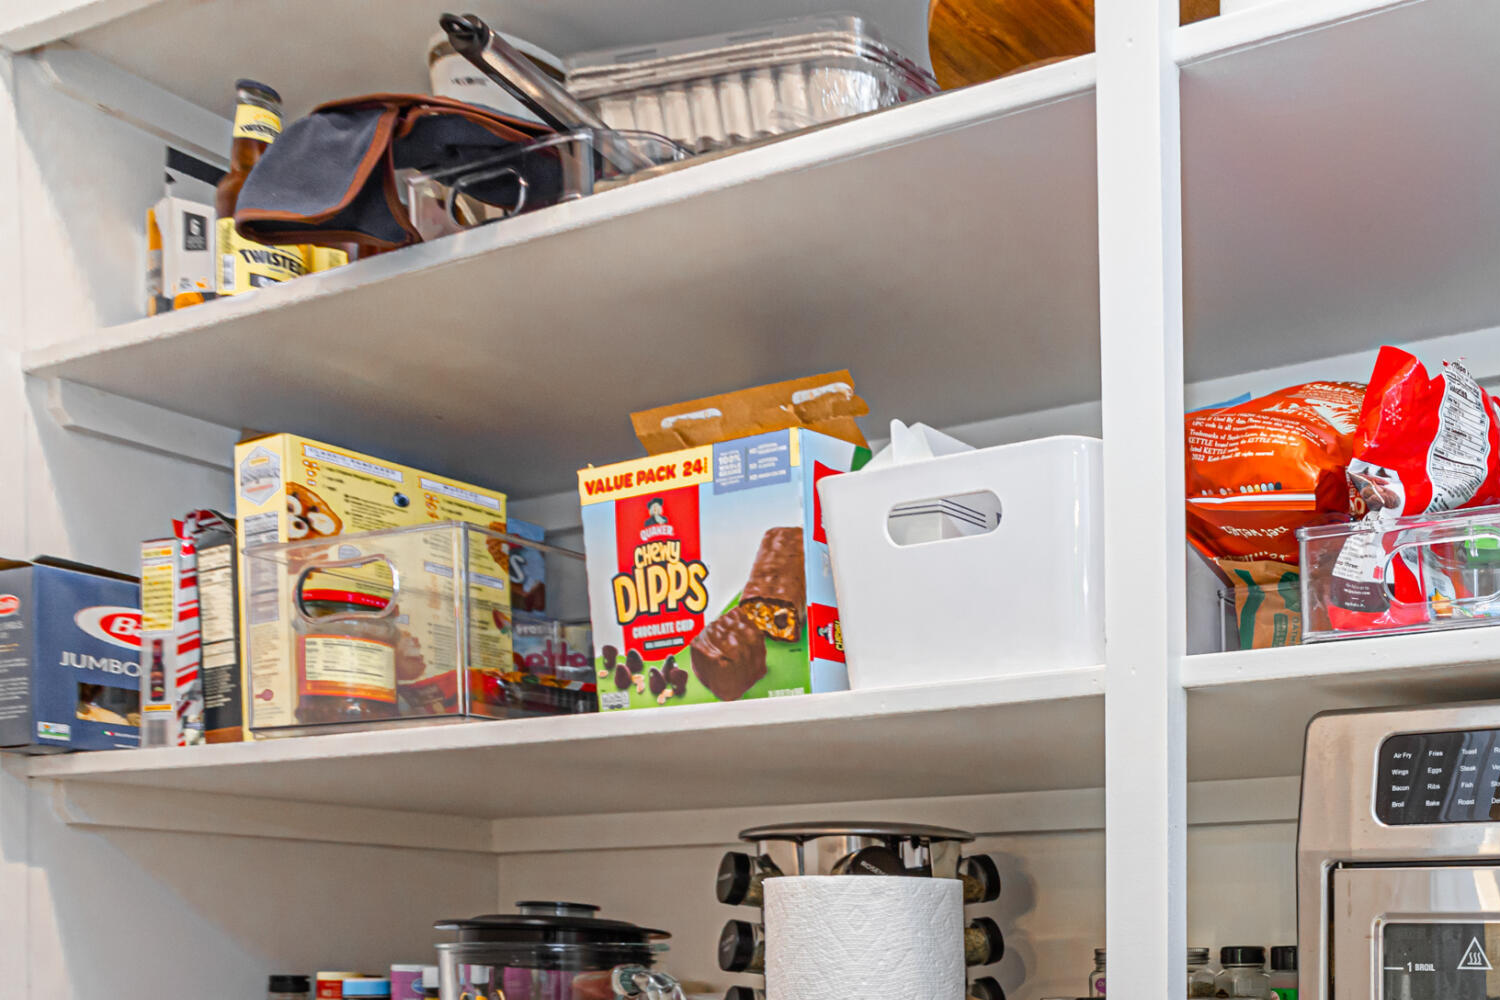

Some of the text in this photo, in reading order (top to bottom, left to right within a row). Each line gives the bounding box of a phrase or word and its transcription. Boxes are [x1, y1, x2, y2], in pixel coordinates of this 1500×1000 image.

[584, 472, 634, 496] VALUE
[636, 464, 677, 486] PACK
[683, 461, 703, 477] 24
[640, 525, 675, 541] QUAKER
[612, 560, 710, 627] DIPPS
[632, 618, 695, 639] CHOCOLATE CHIP
[58, 651, 142, 677] JUMBO
[1403, 752, 1412, 760] Fry
[1391, 768, 1409, 776] Wings
[1457, 798, 1475, 806] Roast
[1407, 961, 1436, 972] 1 BROIL
